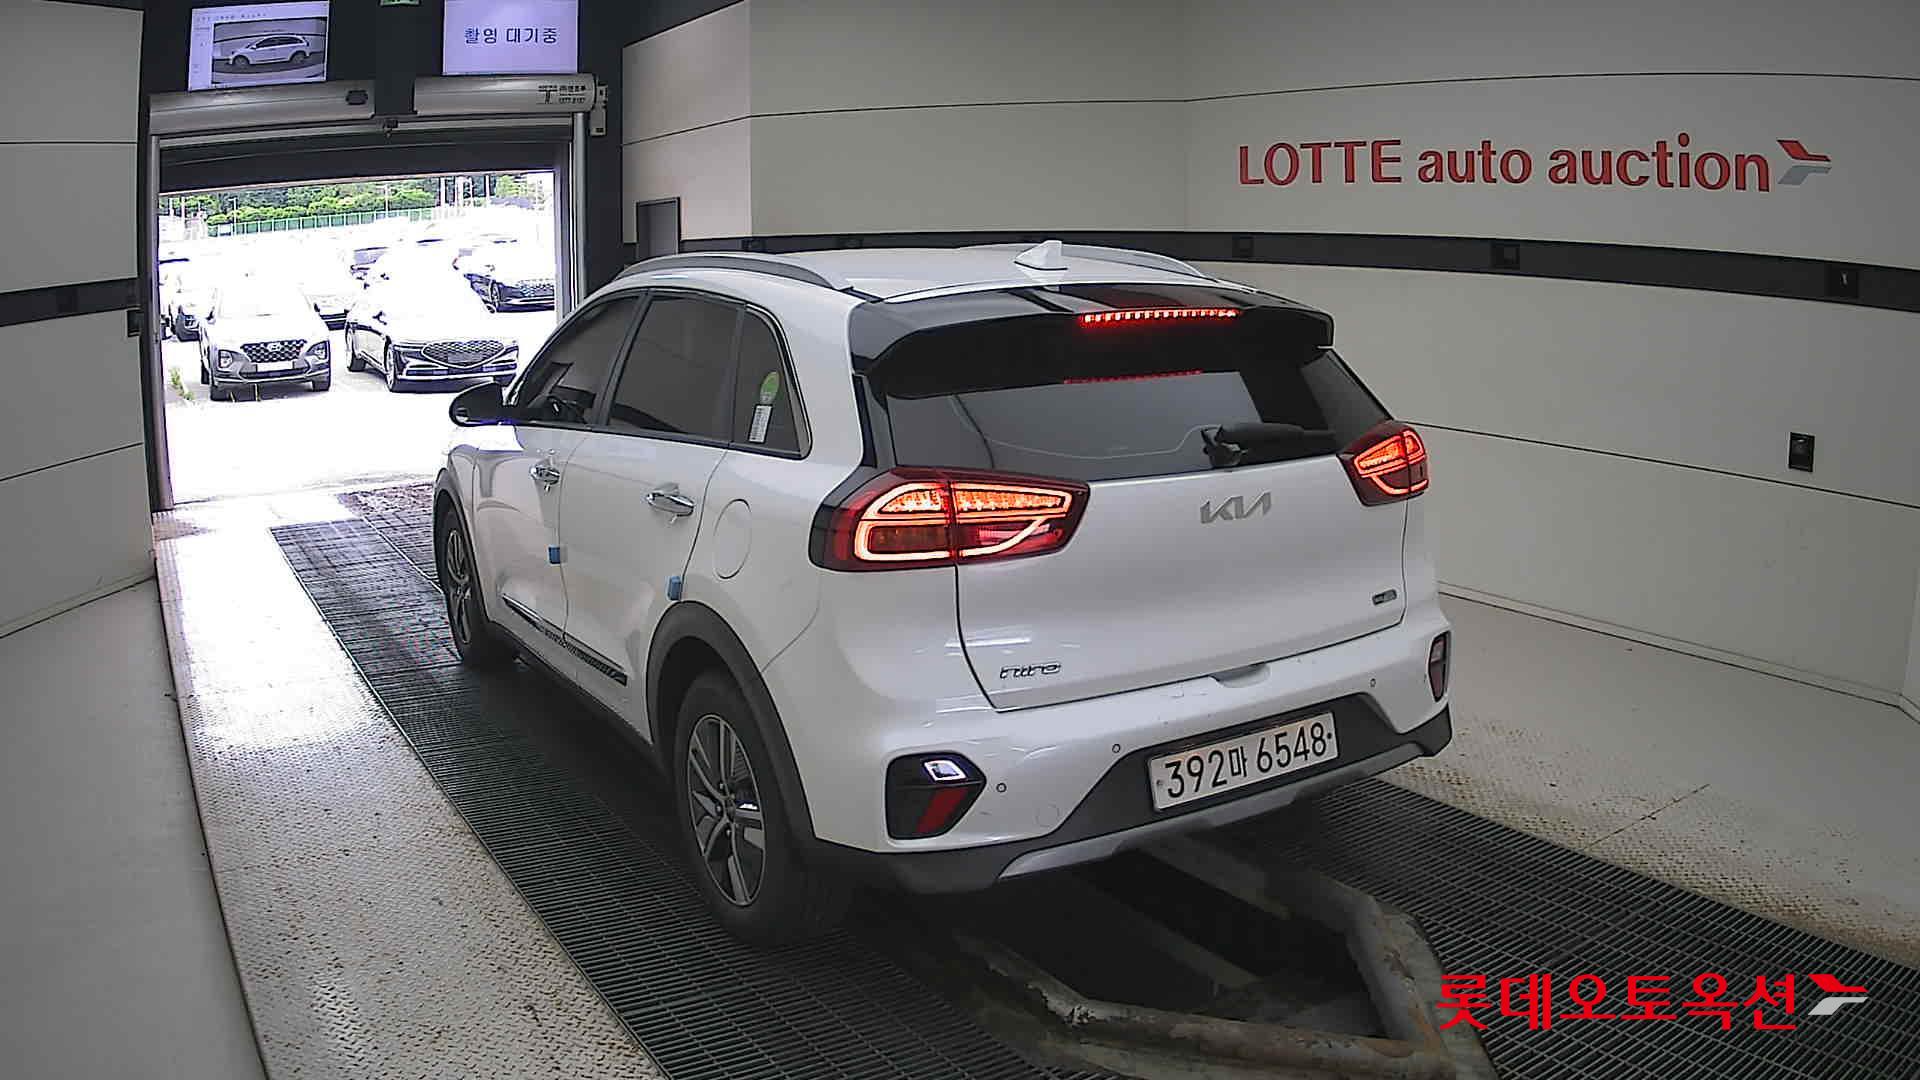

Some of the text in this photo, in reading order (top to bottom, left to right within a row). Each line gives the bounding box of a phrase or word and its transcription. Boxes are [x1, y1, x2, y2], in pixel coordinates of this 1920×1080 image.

[506, 27, 557, 44] 대기중
[1239, 133, 1771, 192] LOTTE auto auction
[1200, 492, 1271, 524] KIA
[1164, 722, 1327, 799] 392마 6548
